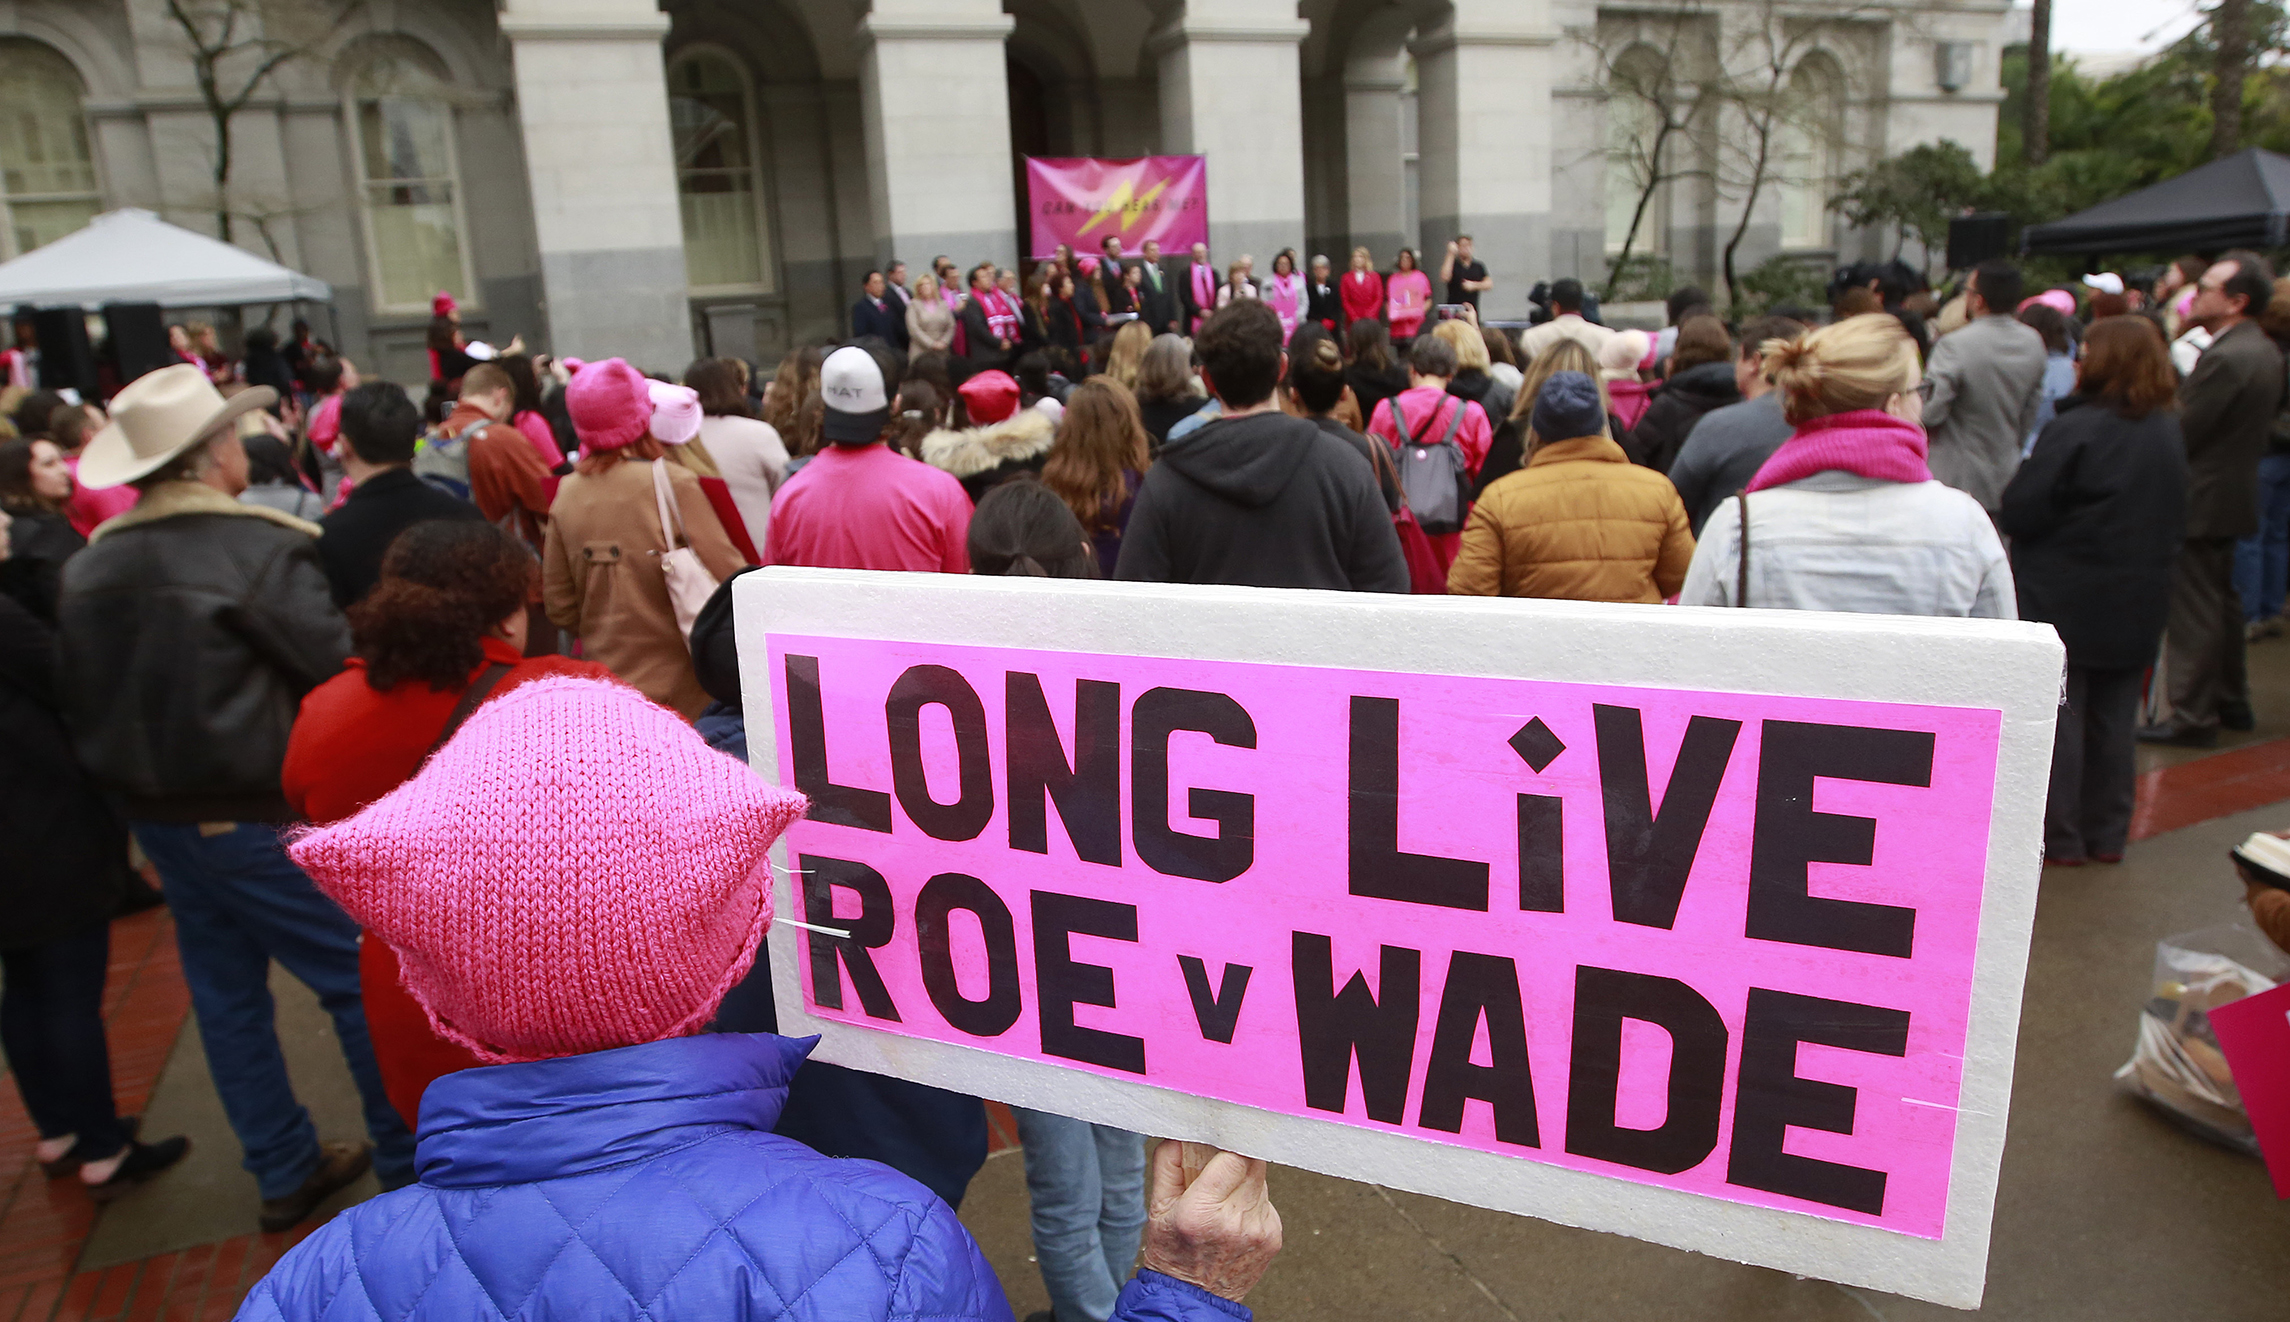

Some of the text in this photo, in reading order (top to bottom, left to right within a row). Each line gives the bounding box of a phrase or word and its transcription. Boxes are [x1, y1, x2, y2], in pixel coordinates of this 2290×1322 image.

[785, 654, 1256, 883] LONG
[799, 853, 1146, 1075] ROE
[1292, 930, 1911, 1217] WADE
